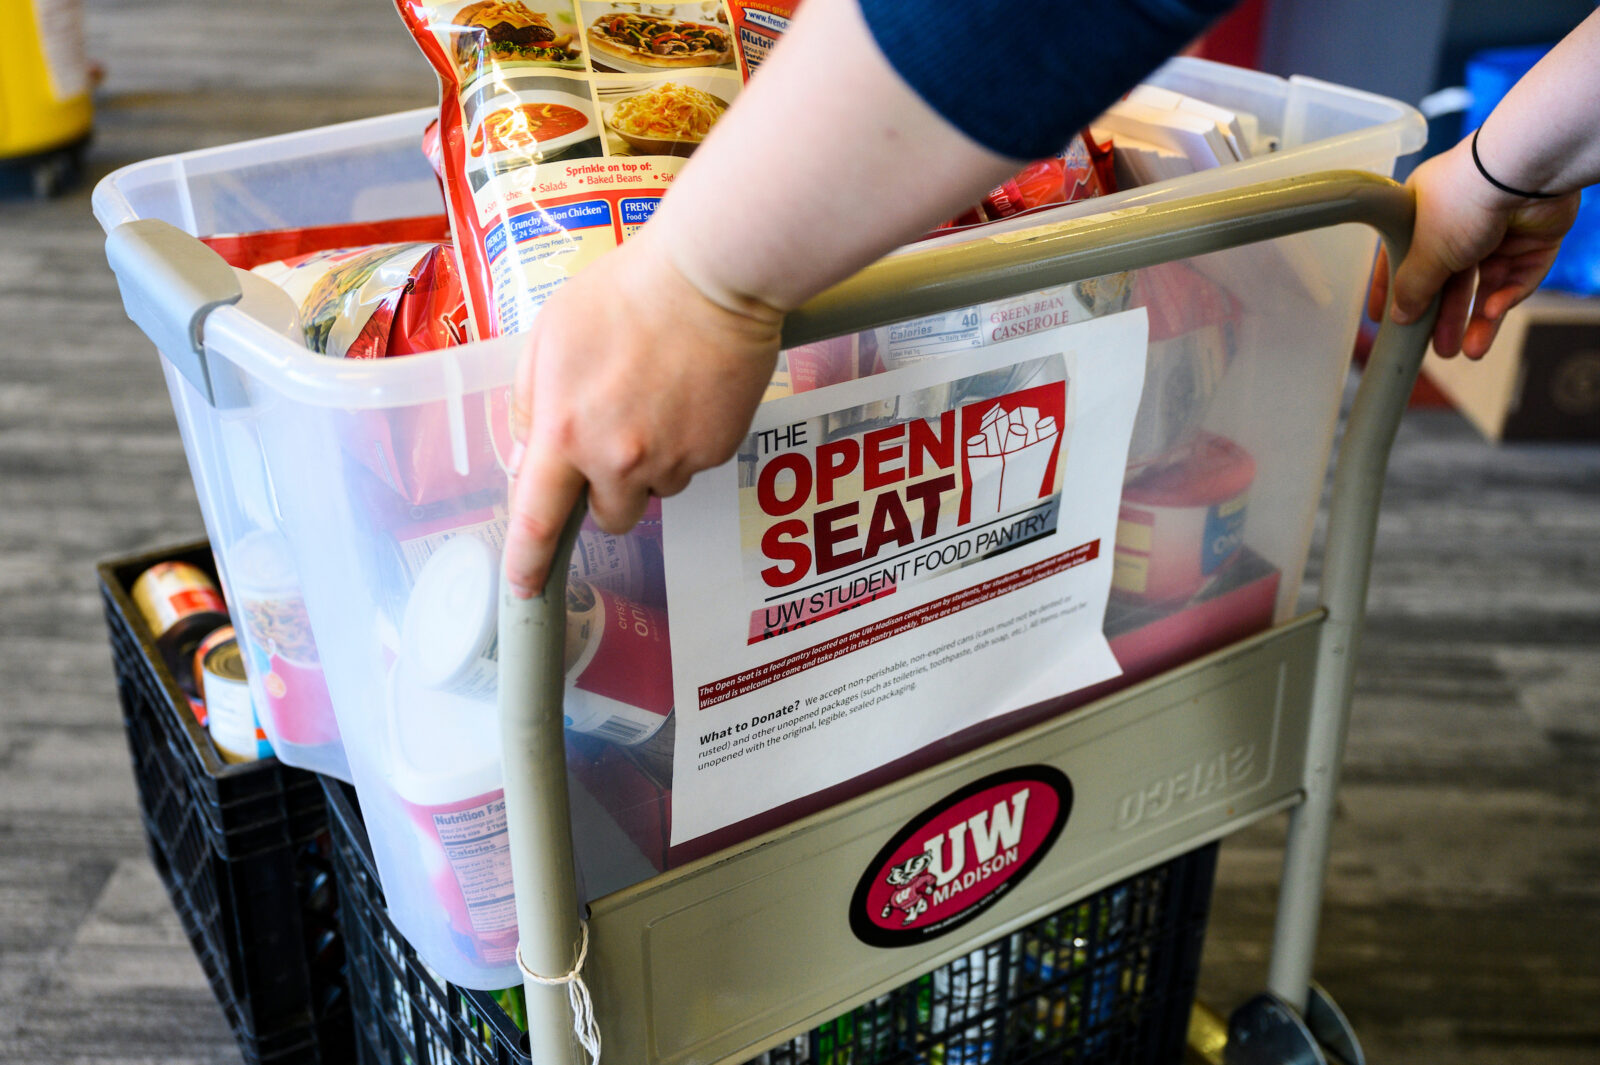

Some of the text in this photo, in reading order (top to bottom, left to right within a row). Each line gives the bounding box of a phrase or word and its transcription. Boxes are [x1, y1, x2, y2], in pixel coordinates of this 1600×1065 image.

[539, 181, 568, 193] Salads
[586, 175, 614, 185] Baked
[616, 174, 643, 183] Beans
[661, 172, 674, 182] Sid
[566, 162, 653, 177] Sprinkle on top of:
[510, 214, 541, 231] Crunchy
[626, 213, 642, 221] Food
[519, 229, 528, 239] 24
[890, 313, 978, 340] Calories 40
[990, 296, 1064, 324] GREEN BEAN
[992, 310, 1069, 342] CASSEROLE
[758, 421, 808, 454] THE
[757, 409, 956, 517] OPEN
[760, 473, 956, 588] SEAT
[765, 598, 807, 628] UW
[809, 560, 911, 615] STUDENT
[912, 539, 971, 576] FOOD
[975, 509, 1053, 554] PANTRY
[700, 687, 713, 696] The
[715, 679, 736, 692] Open
[737, 673, 755, 683] Seat
[755, 669, 762, 677] is
[769, 660, 786, 671] food
[786, 650, 811, 666] pantry
[811, 639, 839, 655] located
[839, 637, 848, 645] on
[849, 632, 860, 641] the
[861, 616, 903, 636] UW-Madison
[904, 606, 929, 620] campus
[930, 601, 941, 610] run
[943, 598, 952, 607] by
[952, 588, 980, 602] students,
[982, 583, 991, 591] for
[700, 690, 731, 707] Wiscard
[731, 688, 738, 697] is
[739, 678, 772, 693] welcome
[773, 673, 781, 681] to
[781, 665, 801, 678] come
[802, 659, 816, 670] and
[817, 653, 833, 664] take
[833, 646, 849, 659] part
[850, 643, 857, 651] in
[858, 638, 870, 648] the
[870, 630, 893, 645] pantry
[894, 620, 919, 635] weekly.
[921, 612, 939, 623] There
[940, 608, 951, 617] are
[961, 593, 989, 609] financial
[698, 740, 731, 759] rusted)
[733, 734, 750, 747] and
[752, 725, 776, 739] other
[777, 708, 820, 732] unopened
[821, 694, 859, 715] packages
[860, 683, 881, 699] (such
[882, 681, 892, 689] as
[893, 665, 928, 684] toiletries,
[930, 648, 972, 669] toothpaste,
[973, 639, 990, 652] dish
[699, 726, 733, 745] What
[735, 722, 748, 733] to
[751, 700, 800, 727] Donate?
[805, 697, 818, 707] We
[819, 684, 846, 701] accept
[848, 660, 909, 688] non-perishable,
[910, 640, 956, 664] non-expired
[957, 633, 974, 646] cans
[975, 626, 995, 640] (cans
[697, 748, 744, 771] unopened
[745, 741, 765, 754] with
[767, 735, 781, 747] the
[782, 721, 817, 740] original,
[818, 710, 848, 727] legible,
[849, 698, 875, 714] sealed
[435, 801, 506, 826] Nutrition Fac
[449, 843, 497, 858] Calories
[923, 787, 1030, 887] UW
[932, 847, 1019, 906] MADISON
